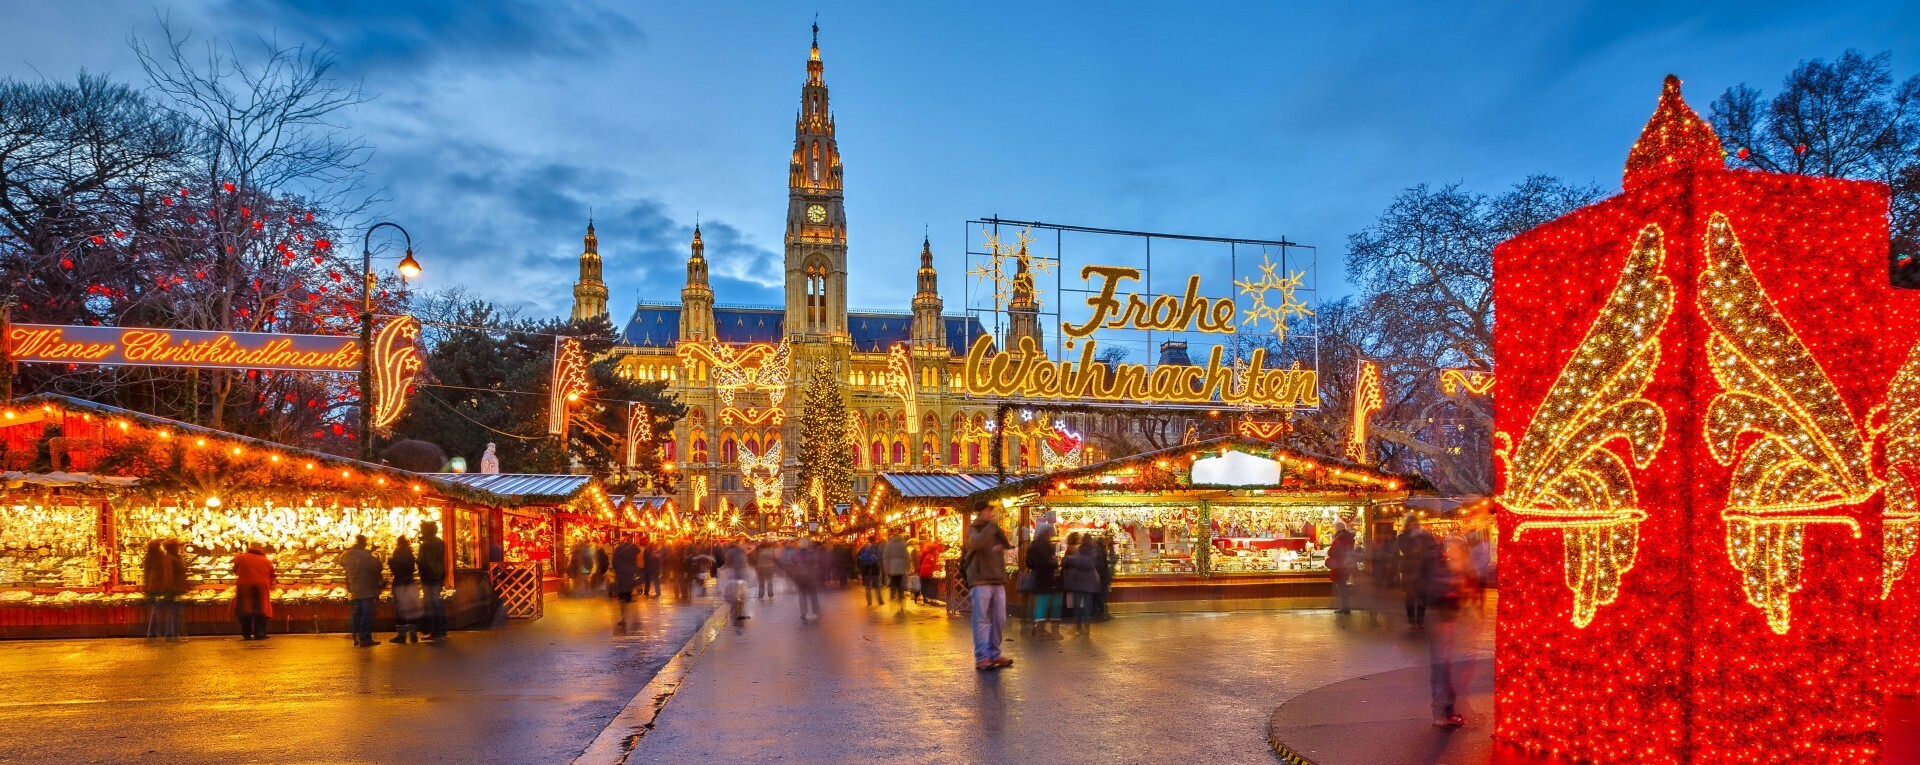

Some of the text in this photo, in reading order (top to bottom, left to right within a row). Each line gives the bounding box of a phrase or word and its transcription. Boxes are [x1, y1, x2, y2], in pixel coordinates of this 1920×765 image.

[1062, 265, 1236, 336] Frohe
[10, 329, 362, 368] Wiener Christkindlmarkt
[966, 334, 1320, 404] Weihnachten
